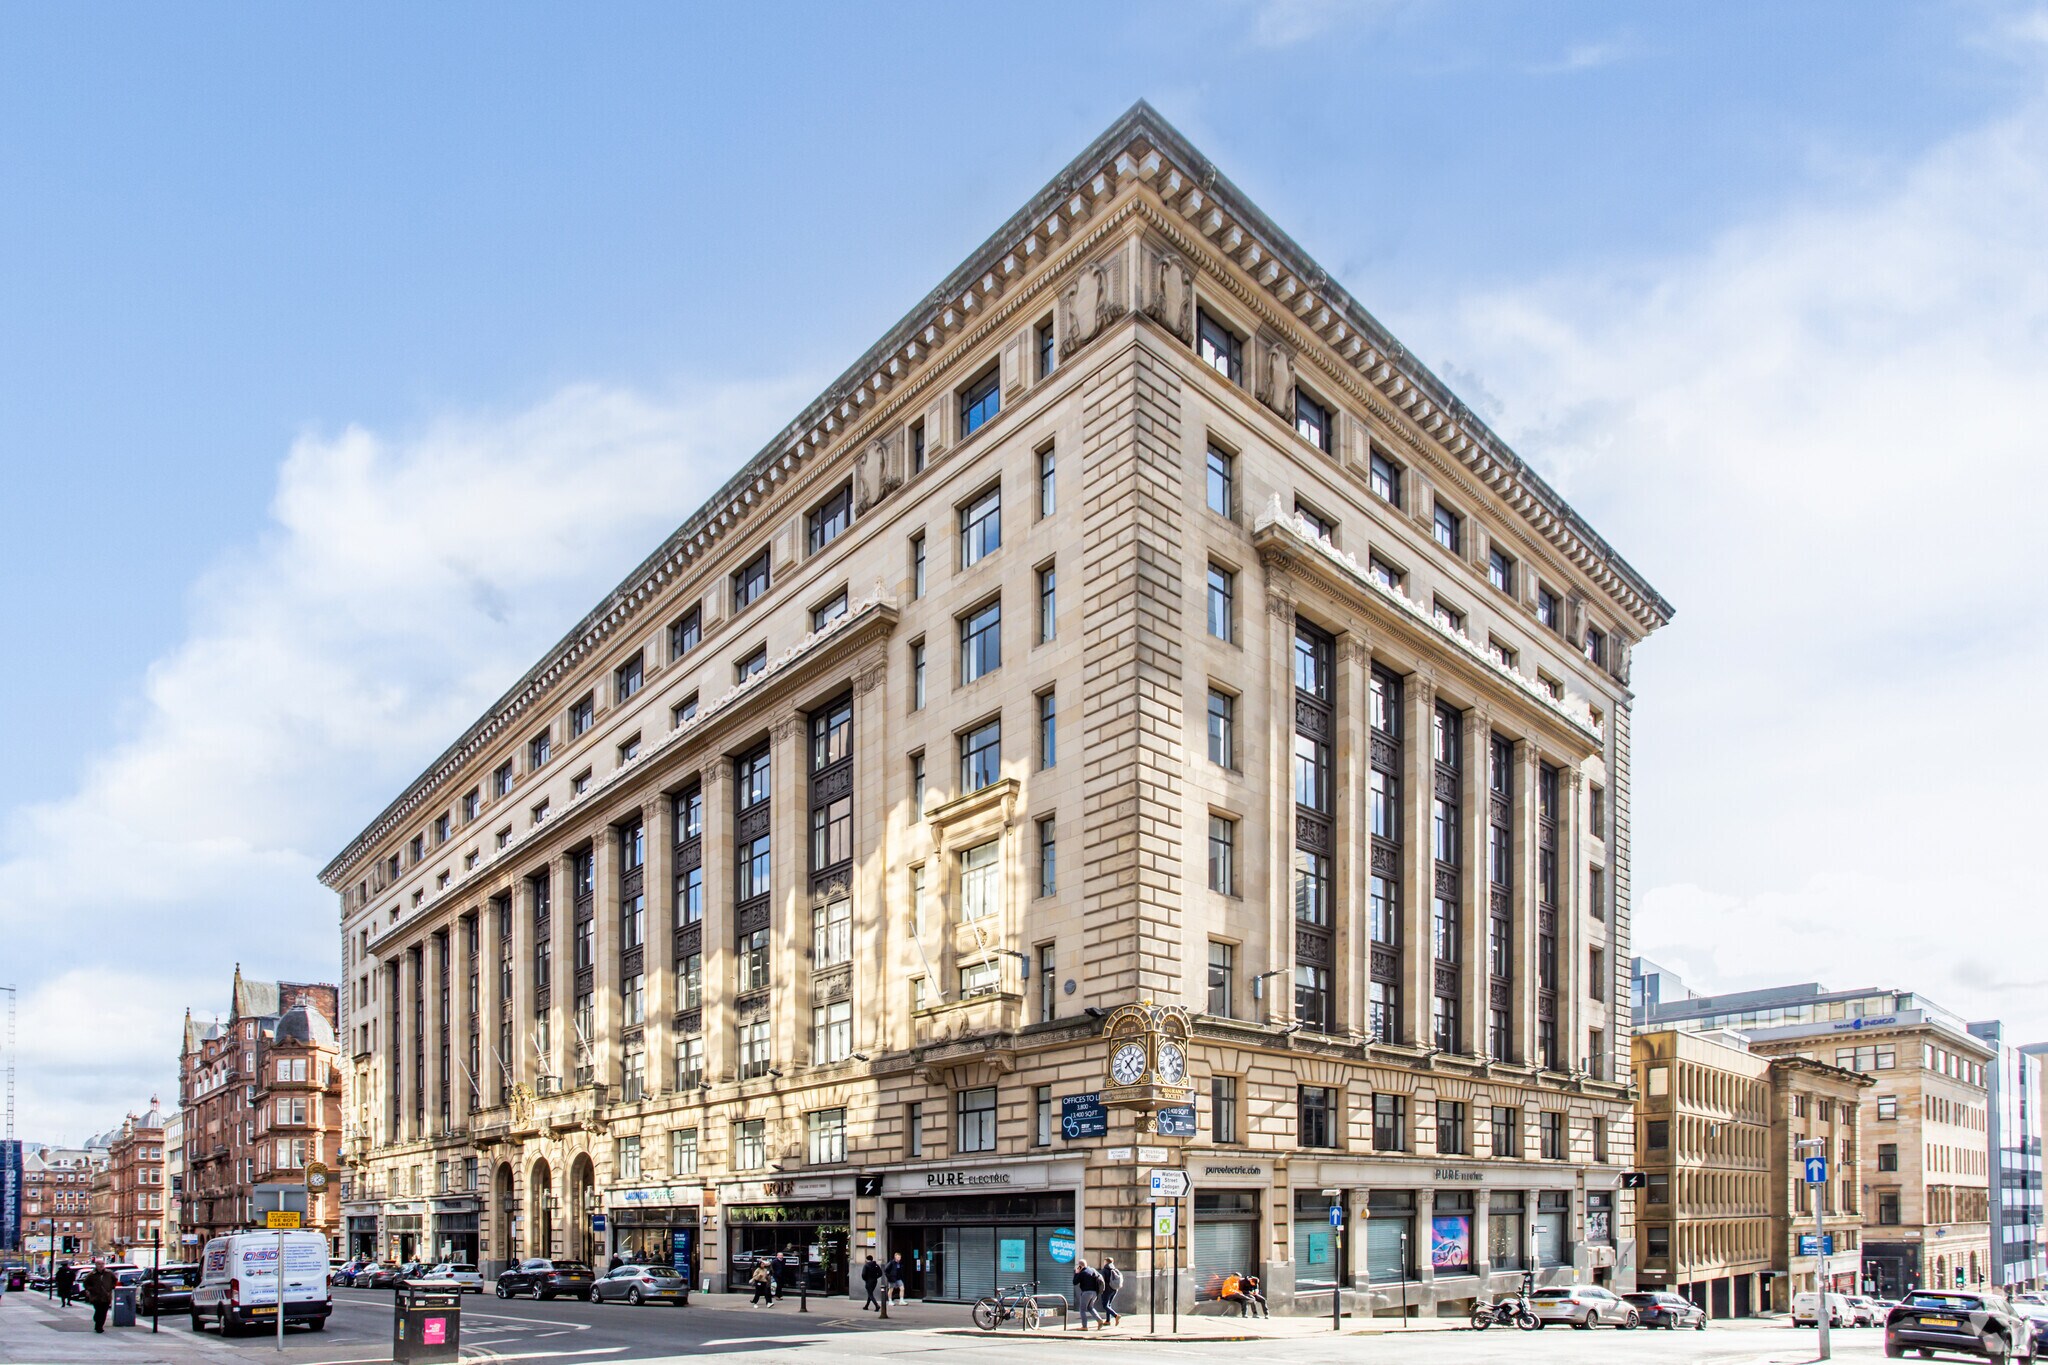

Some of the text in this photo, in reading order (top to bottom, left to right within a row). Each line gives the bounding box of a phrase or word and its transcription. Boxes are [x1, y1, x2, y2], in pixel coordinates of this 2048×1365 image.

[1864, 1017, 1896, 1027] INDIGO
[1063, 1095, 1086, 1105] OFFICES
[1086, 1094, 1095, 1102] TO
[1063, 1116, 1080, 1137] 95
[1158, 1111, 1174, 1133] 95
[1205, 1165, 1261, 1175] pureelectric.com
[1435, 1169, 1459, 1180] PURE
[927, 1172, 1010, 1186] PURE ELECTRIC
[624, 1190, 649, 1200] LAUNCH
